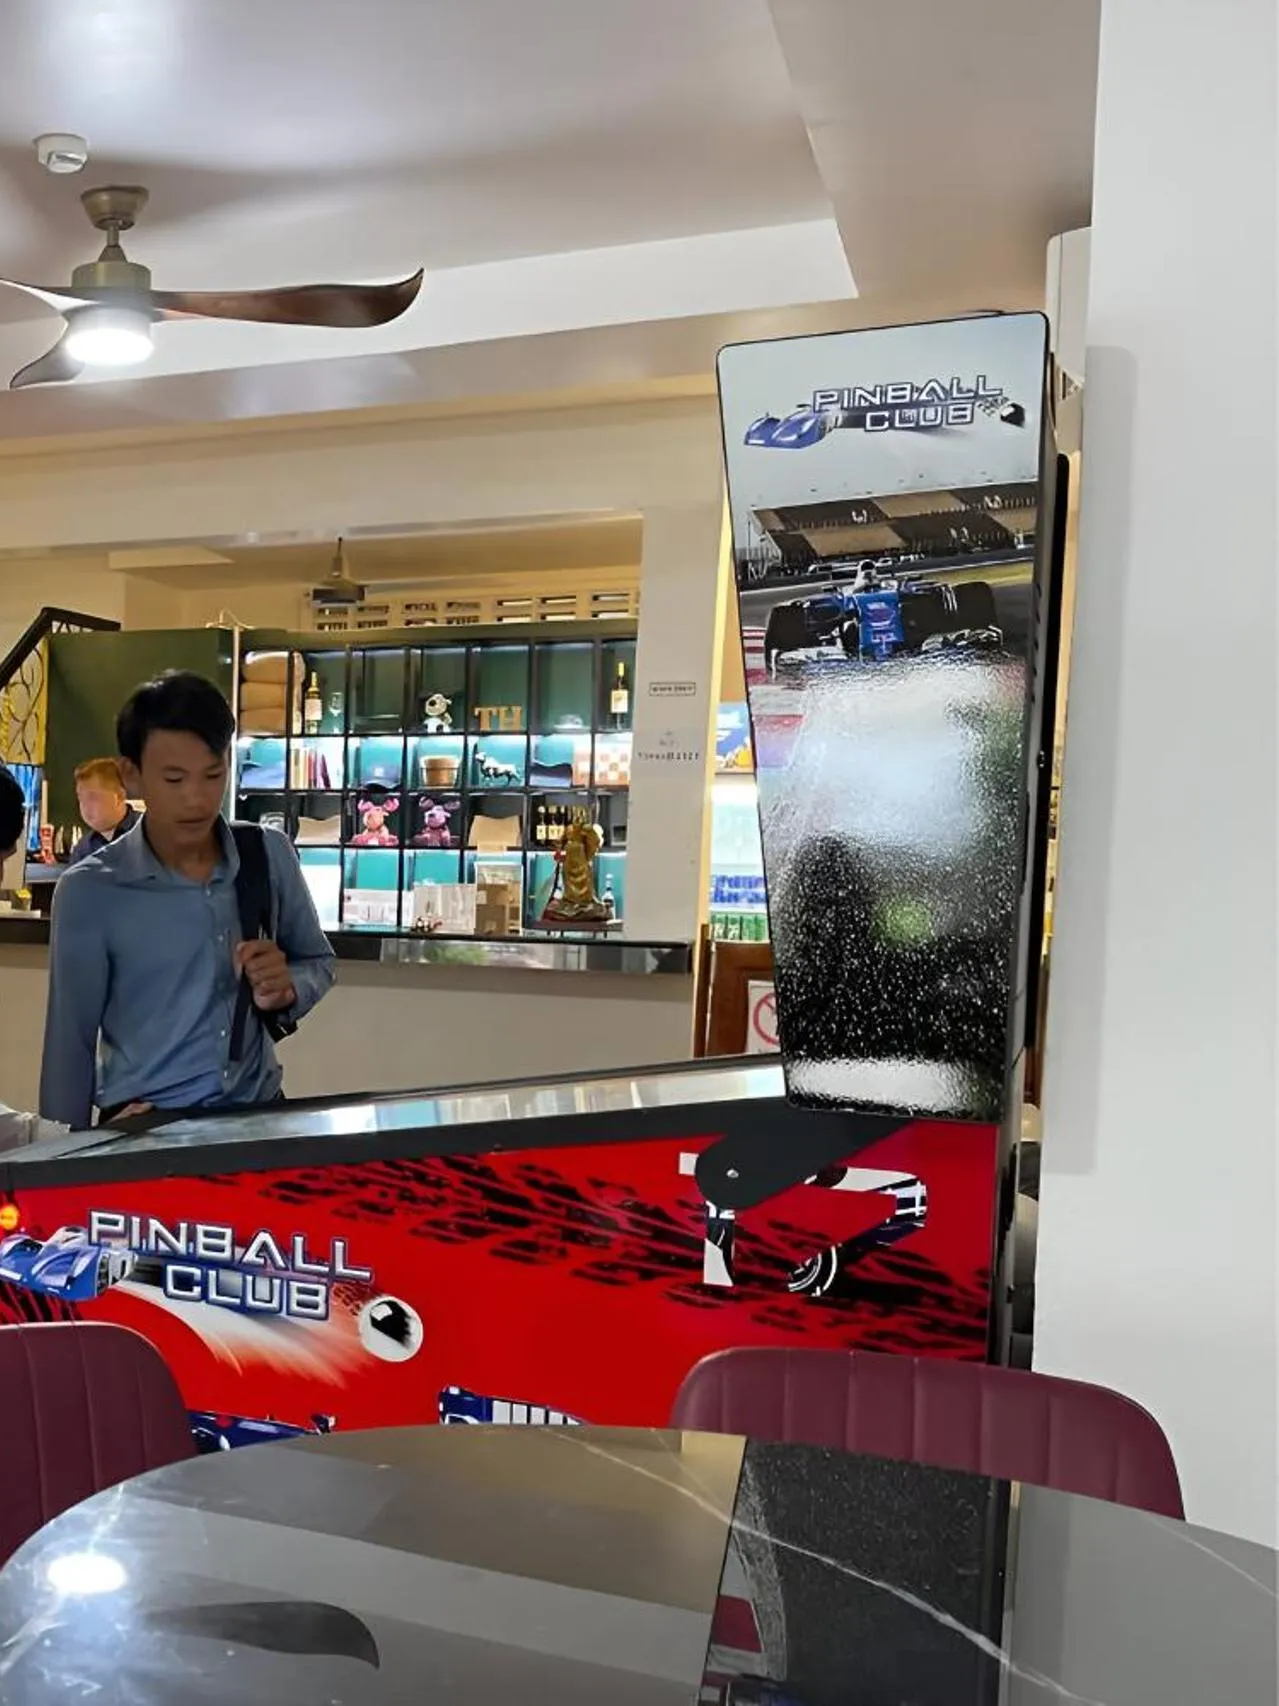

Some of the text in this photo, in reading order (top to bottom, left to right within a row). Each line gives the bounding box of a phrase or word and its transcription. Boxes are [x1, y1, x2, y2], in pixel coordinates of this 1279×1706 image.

[813, 375, 1004, 412] PINBALL
[864, 402, 974, 432] CLUB
[473, 705, 523, 731] TH
[89, 1209, 375, 1284] PINBALL
[164, 1263, 332, 1322] CLUB
